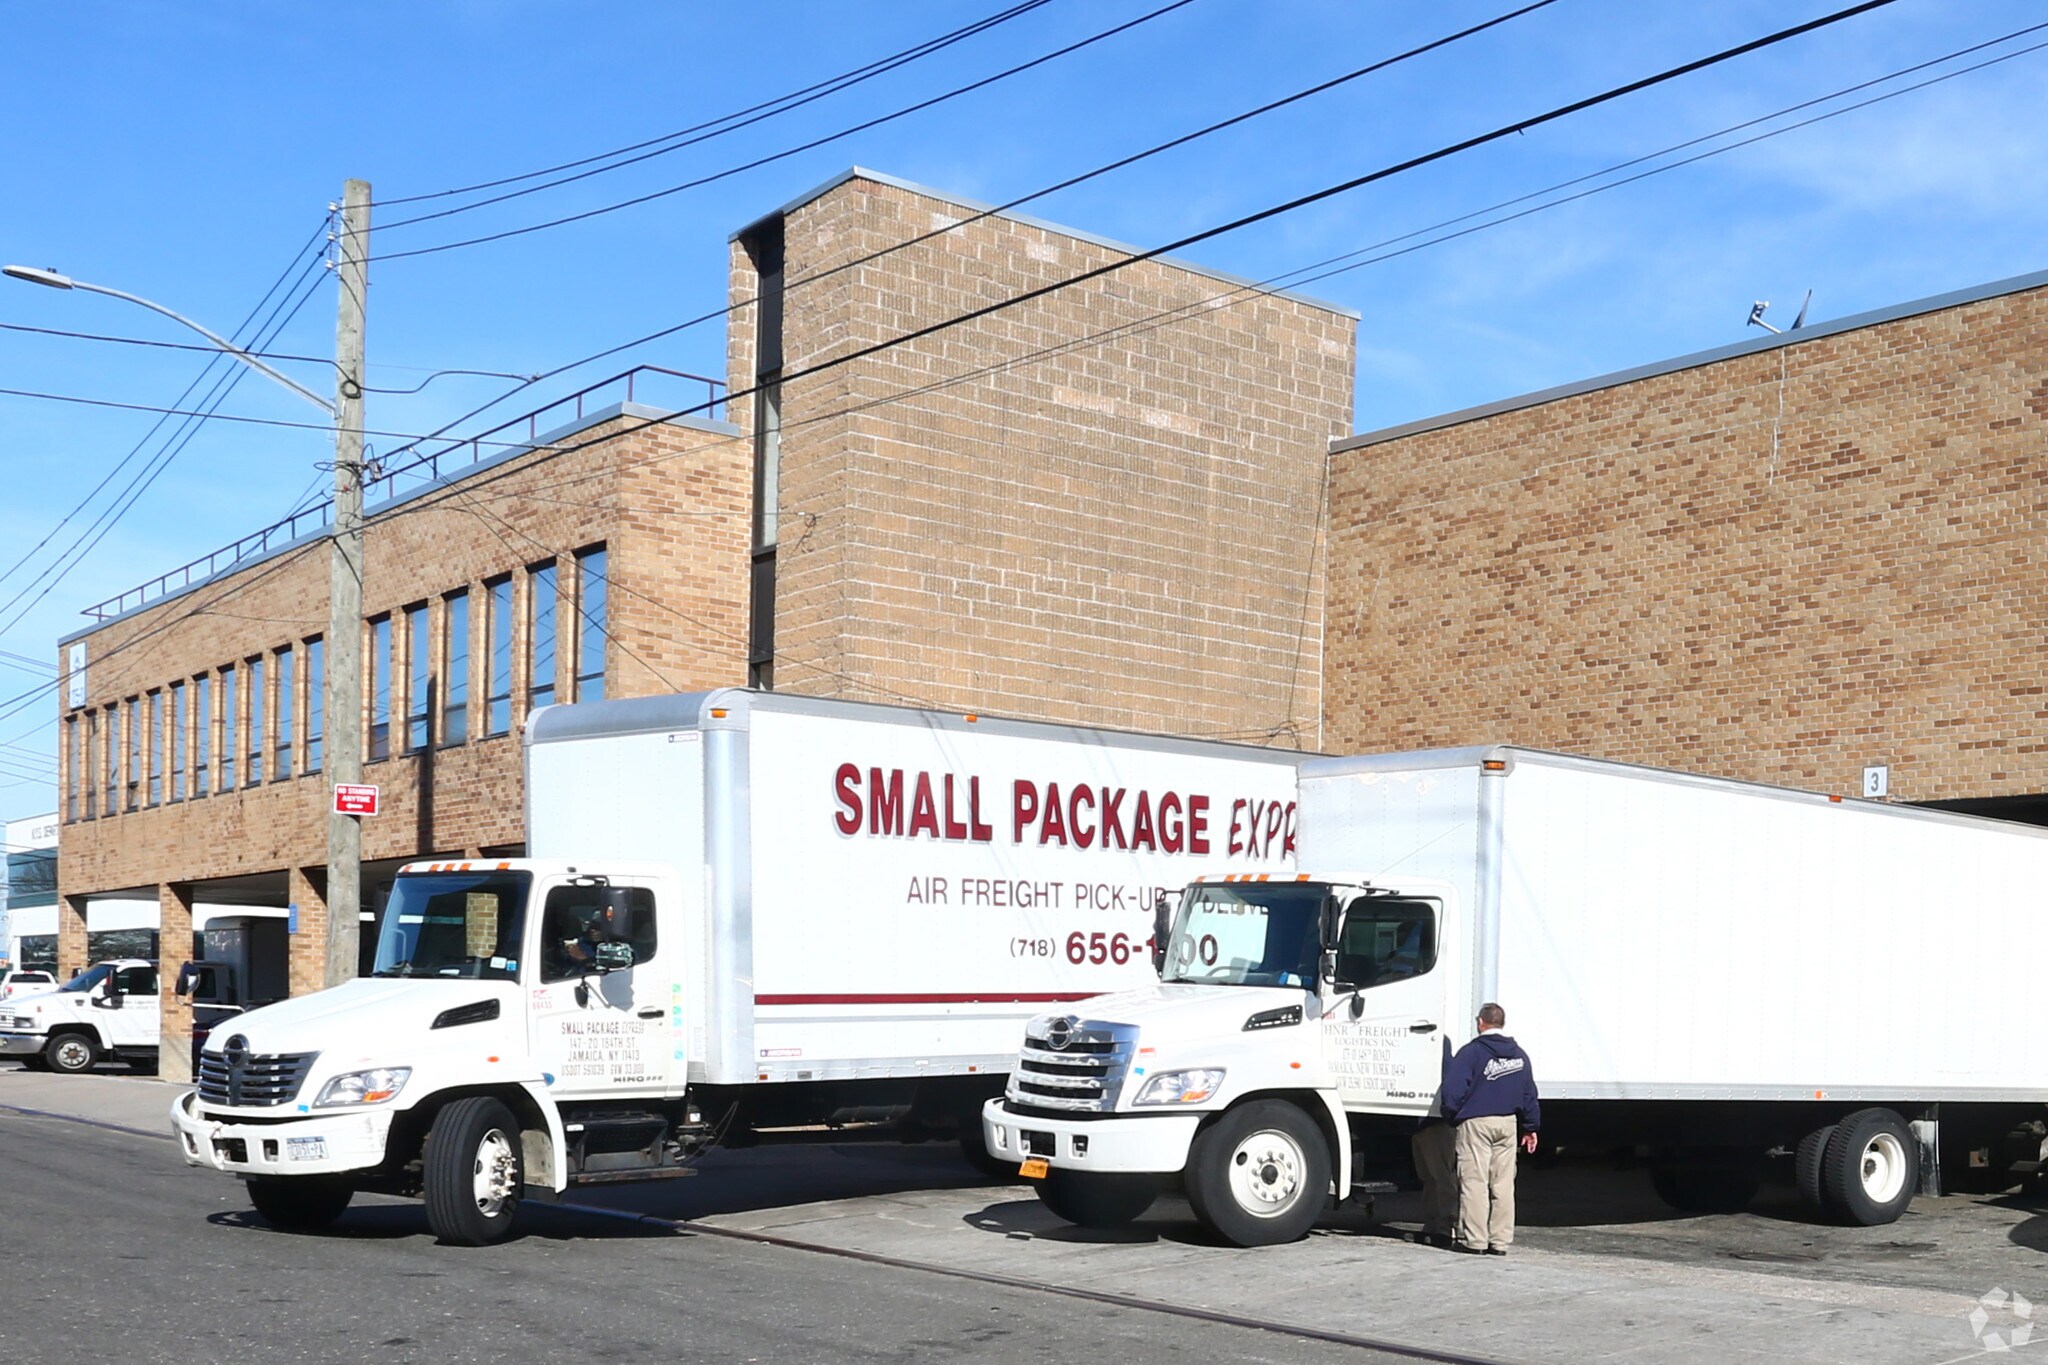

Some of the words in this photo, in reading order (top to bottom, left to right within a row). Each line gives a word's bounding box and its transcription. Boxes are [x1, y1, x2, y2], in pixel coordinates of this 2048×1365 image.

[1870, 772, 1879, 792] 3
[347, 787, 376, 796] STANDING
[341, 794, 371, 803] ANYTIME
[833, 762, 993, 843] SMALL
[1012, 779, 1210, 856] PACKAGE
[906, 876, 948, 904] AIR
[961, 878, 1064, 908] FREIGHT
[1009, 937, 1056, 958] (718)
[561, 1021, 584, 1035] SMALL
[587, 1021, 619, 1034] PACKAGE
[1358, 1026, 1408, 1038] FREIGHT
[569, 1037, 598, 1049] 147-20
[1334, 1037, 1378, 1047] LOGISTICS
[608, 1050, 619, 1061] NY
